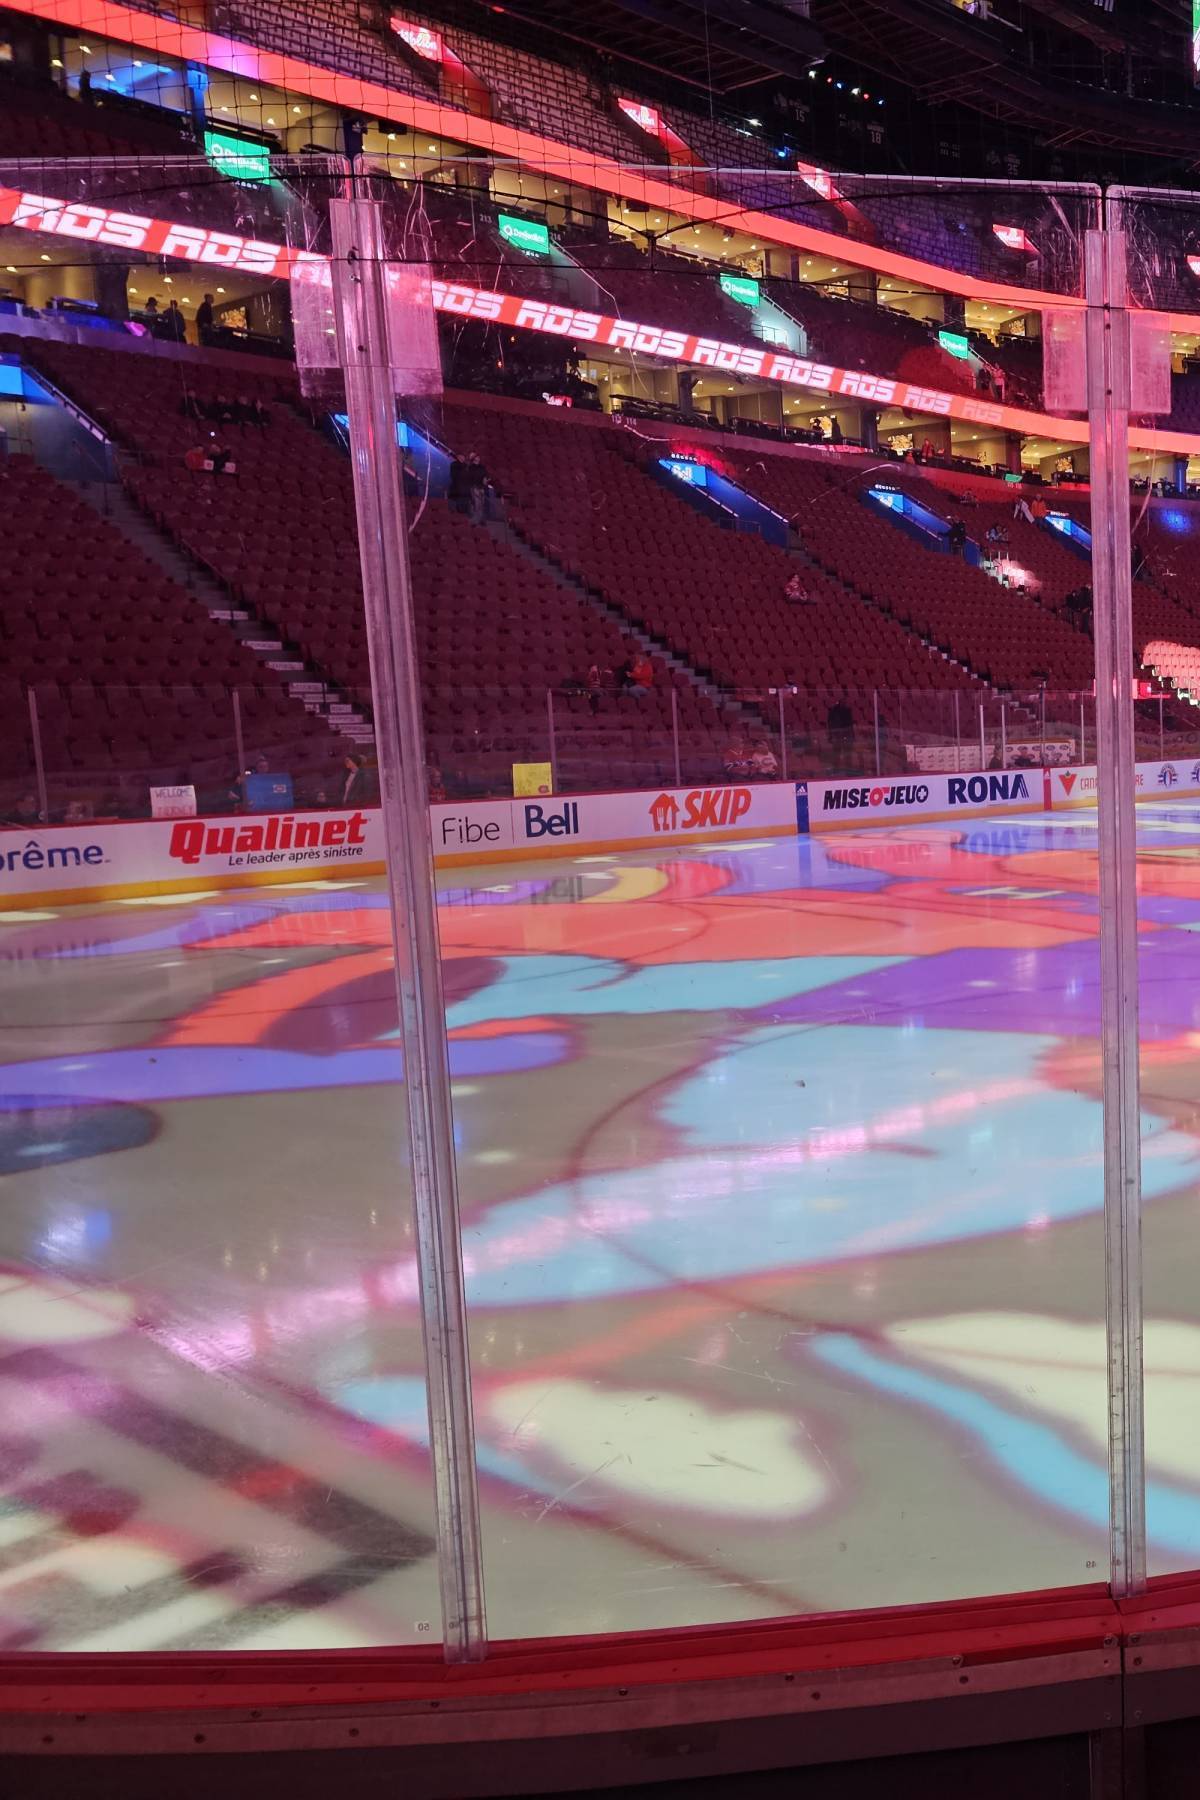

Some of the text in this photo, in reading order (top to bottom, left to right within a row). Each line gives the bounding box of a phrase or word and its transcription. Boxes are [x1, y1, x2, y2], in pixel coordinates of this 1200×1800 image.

[681, 788, 752, 829] SKIP
[948, 774, 1029, 804] RONA
[169, 812, 367, 865] Qualinet
[441, 802, 580, 845] Fibe Bell
[228, 844, 363, 867] Le leader après sinistre
